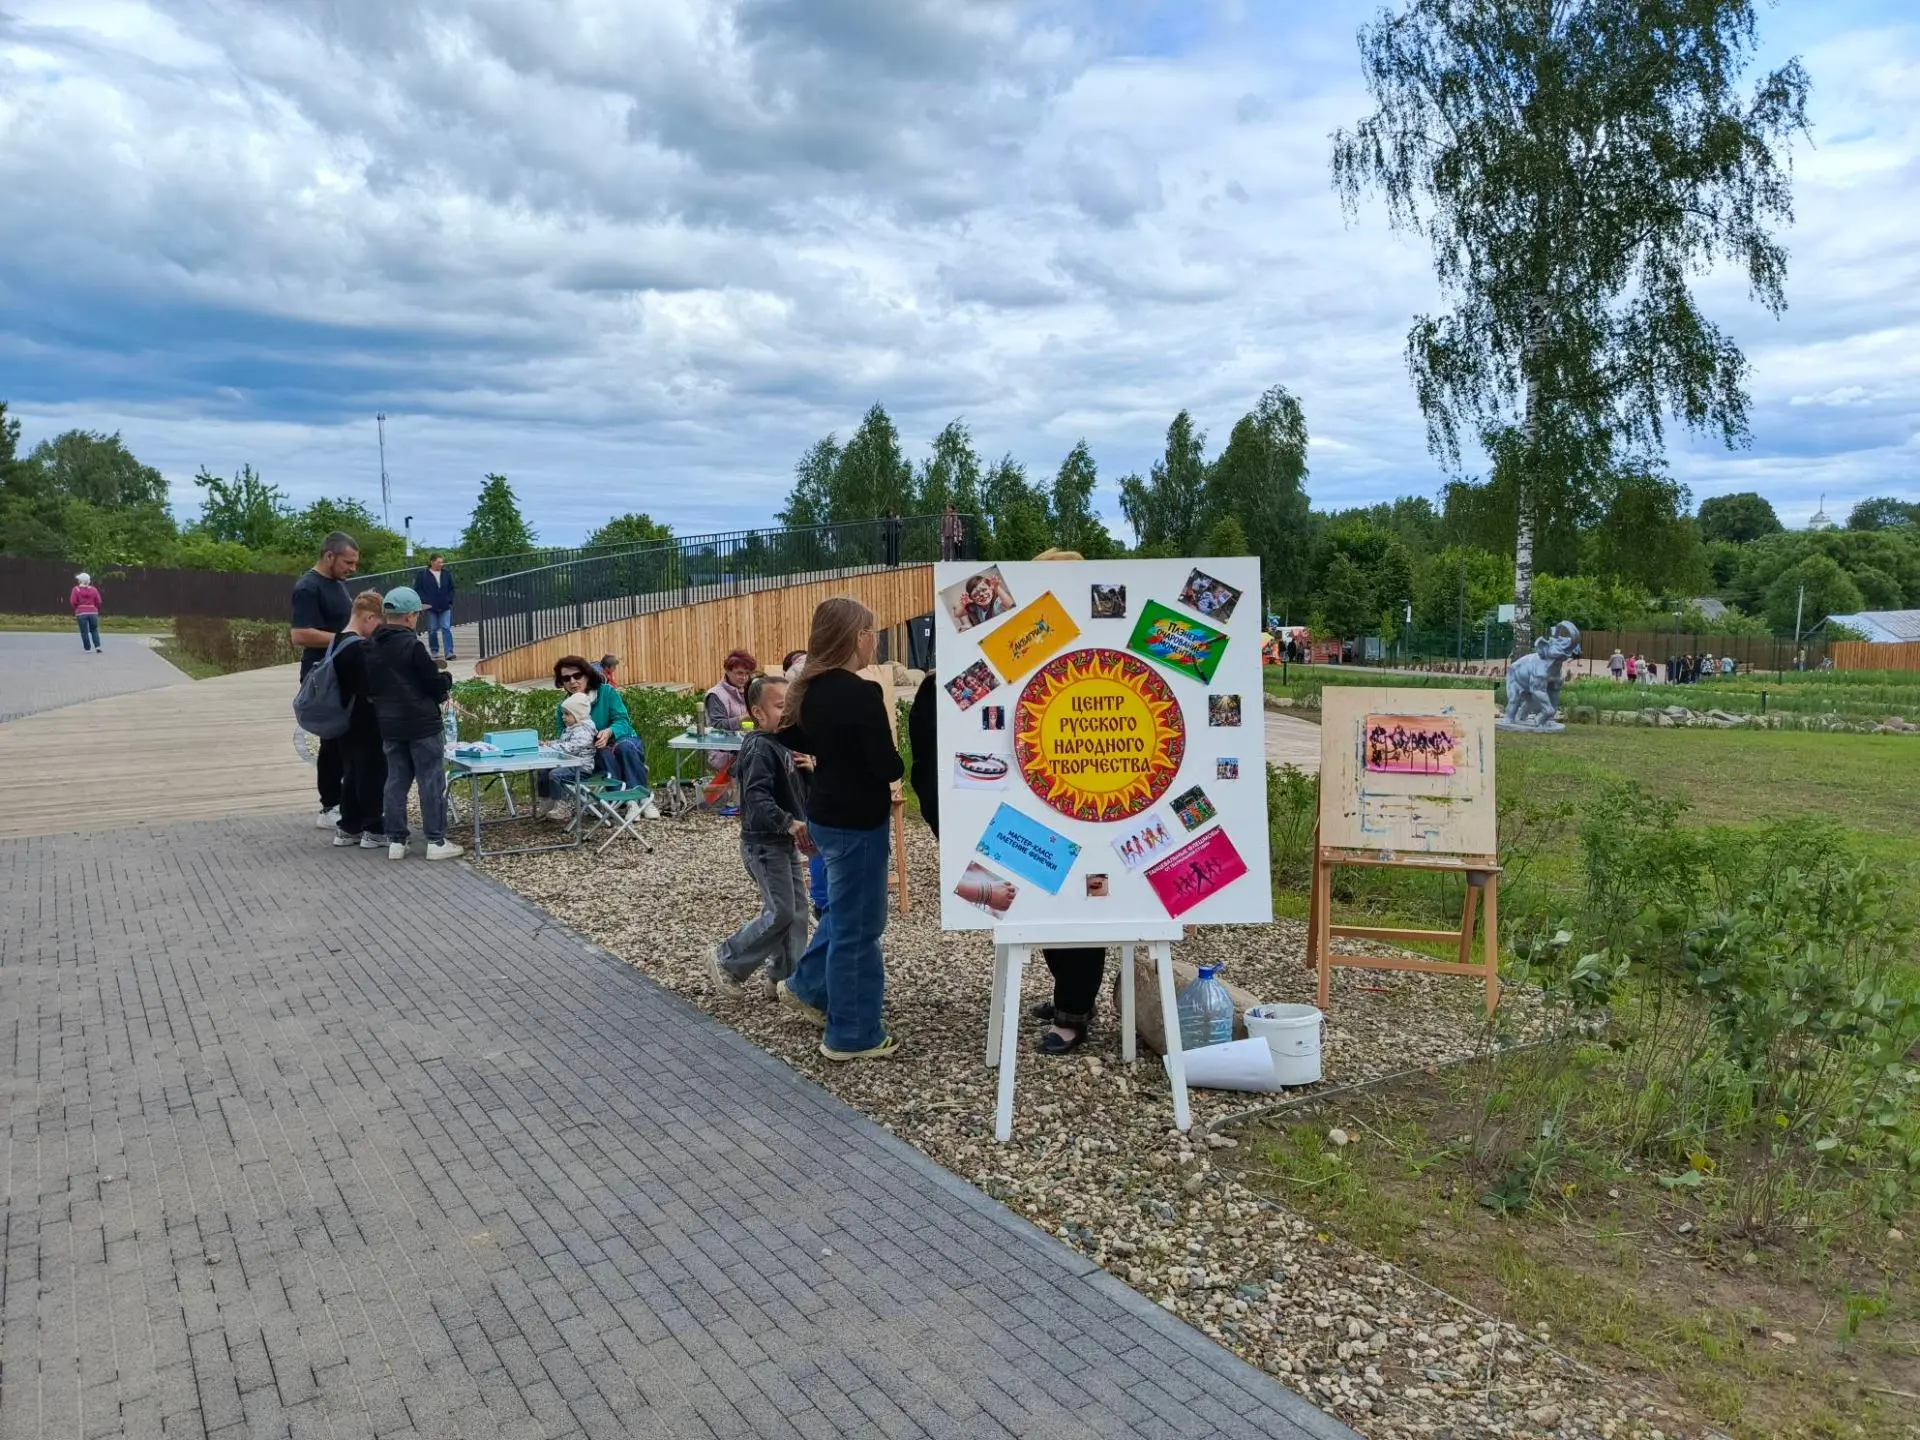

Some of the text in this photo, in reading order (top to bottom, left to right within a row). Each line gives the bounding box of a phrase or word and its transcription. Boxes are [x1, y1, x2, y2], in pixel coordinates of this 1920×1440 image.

[1072, 695, 1124, 714] ЦЕНТР
[1060, 716, 1137, 737] РУССКОГО
[1054, 737, 1144, 756] НАРОДНОГО
[1050, 758, 1151, 775] ТВОРЧЕСТВА
[996, 831, 1028, 855] ПЛЕТЕНИЕ
[1007, 829, 1054, 860] МАСТЕР-КЛАСС
